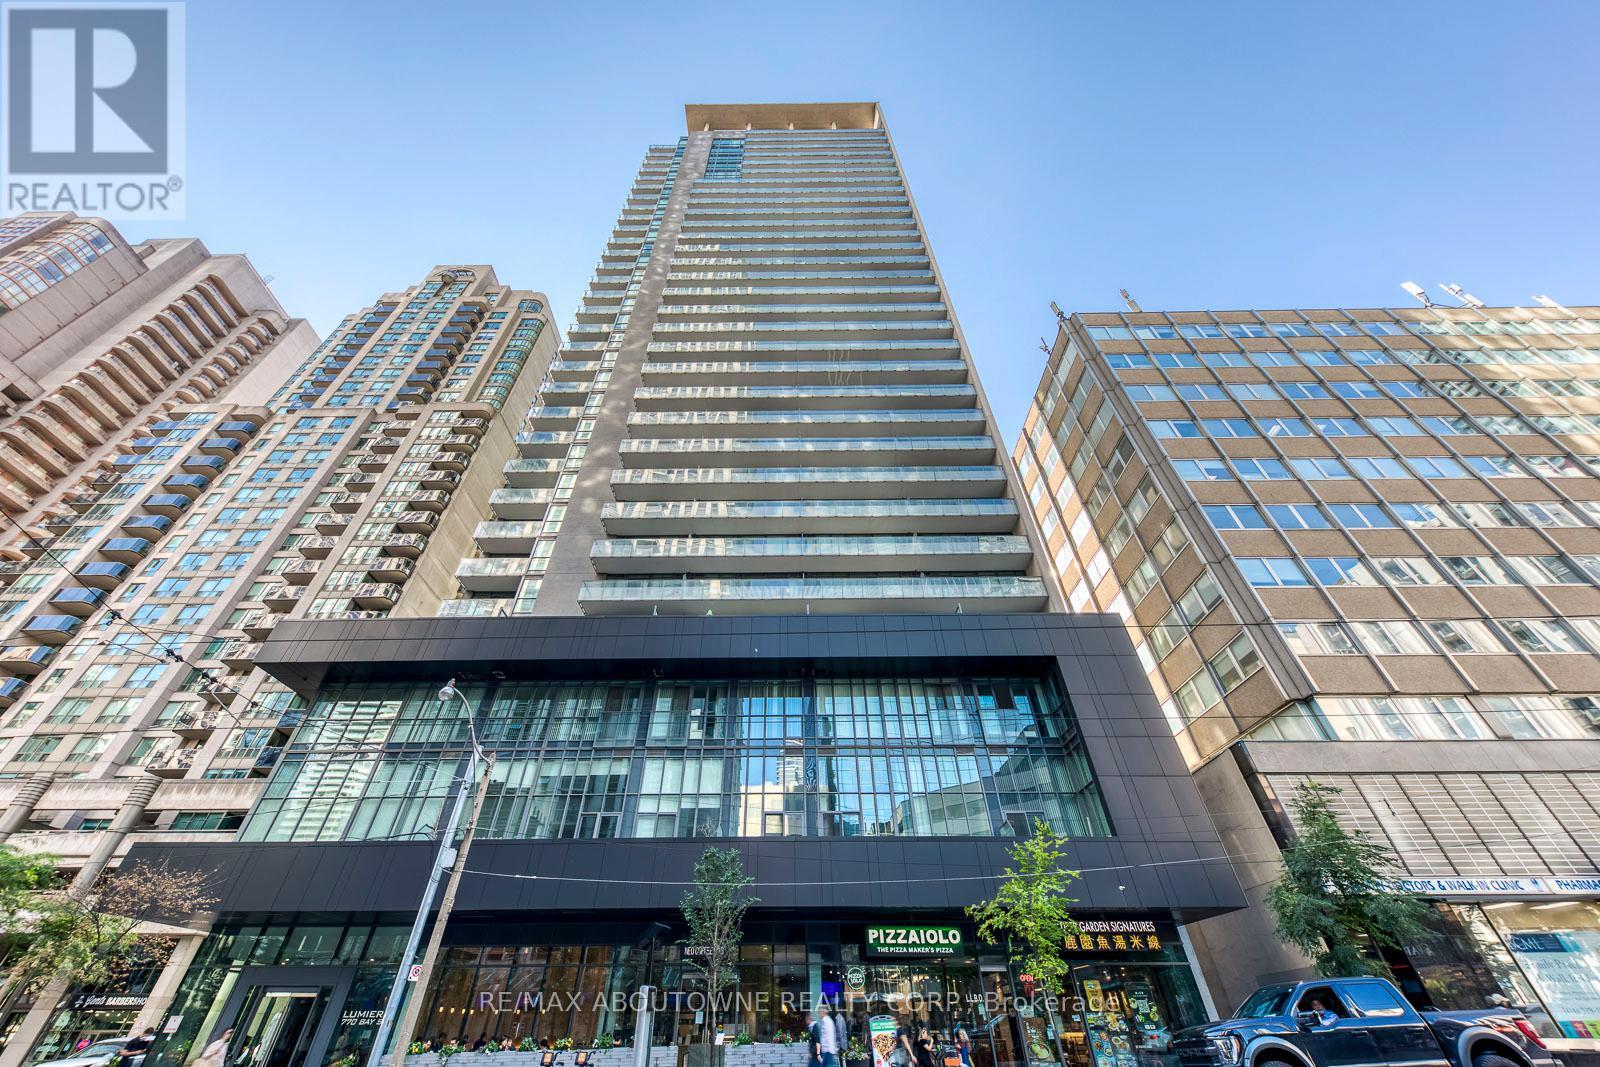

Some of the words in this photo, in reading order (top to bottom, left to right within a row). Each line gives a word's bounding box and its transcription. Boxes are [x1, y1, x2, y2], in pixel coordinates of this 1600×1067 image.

[1391, 880, 1436, 891] OCTORS
[1436, 880, 1447, 891] &
[1446, 880, 1491, 891] WALK-IN
[1491, 880, 1525, 891] CLINIC
[1556, 880, 1600, 890] PHARMA
[1079, 921, 1110, 932] GARDEN
[1110, 921, 1156, 932] SIGNATURES
[868, 929, 961, 944] PIZZAIOLO
[105, 996, 148, 1006] BARBERSHO
[343, 1010, 384, 1018] LUMIER
[341, 1018, 358, 1026] 770
[358, 1018, 376, 1026] BAY
